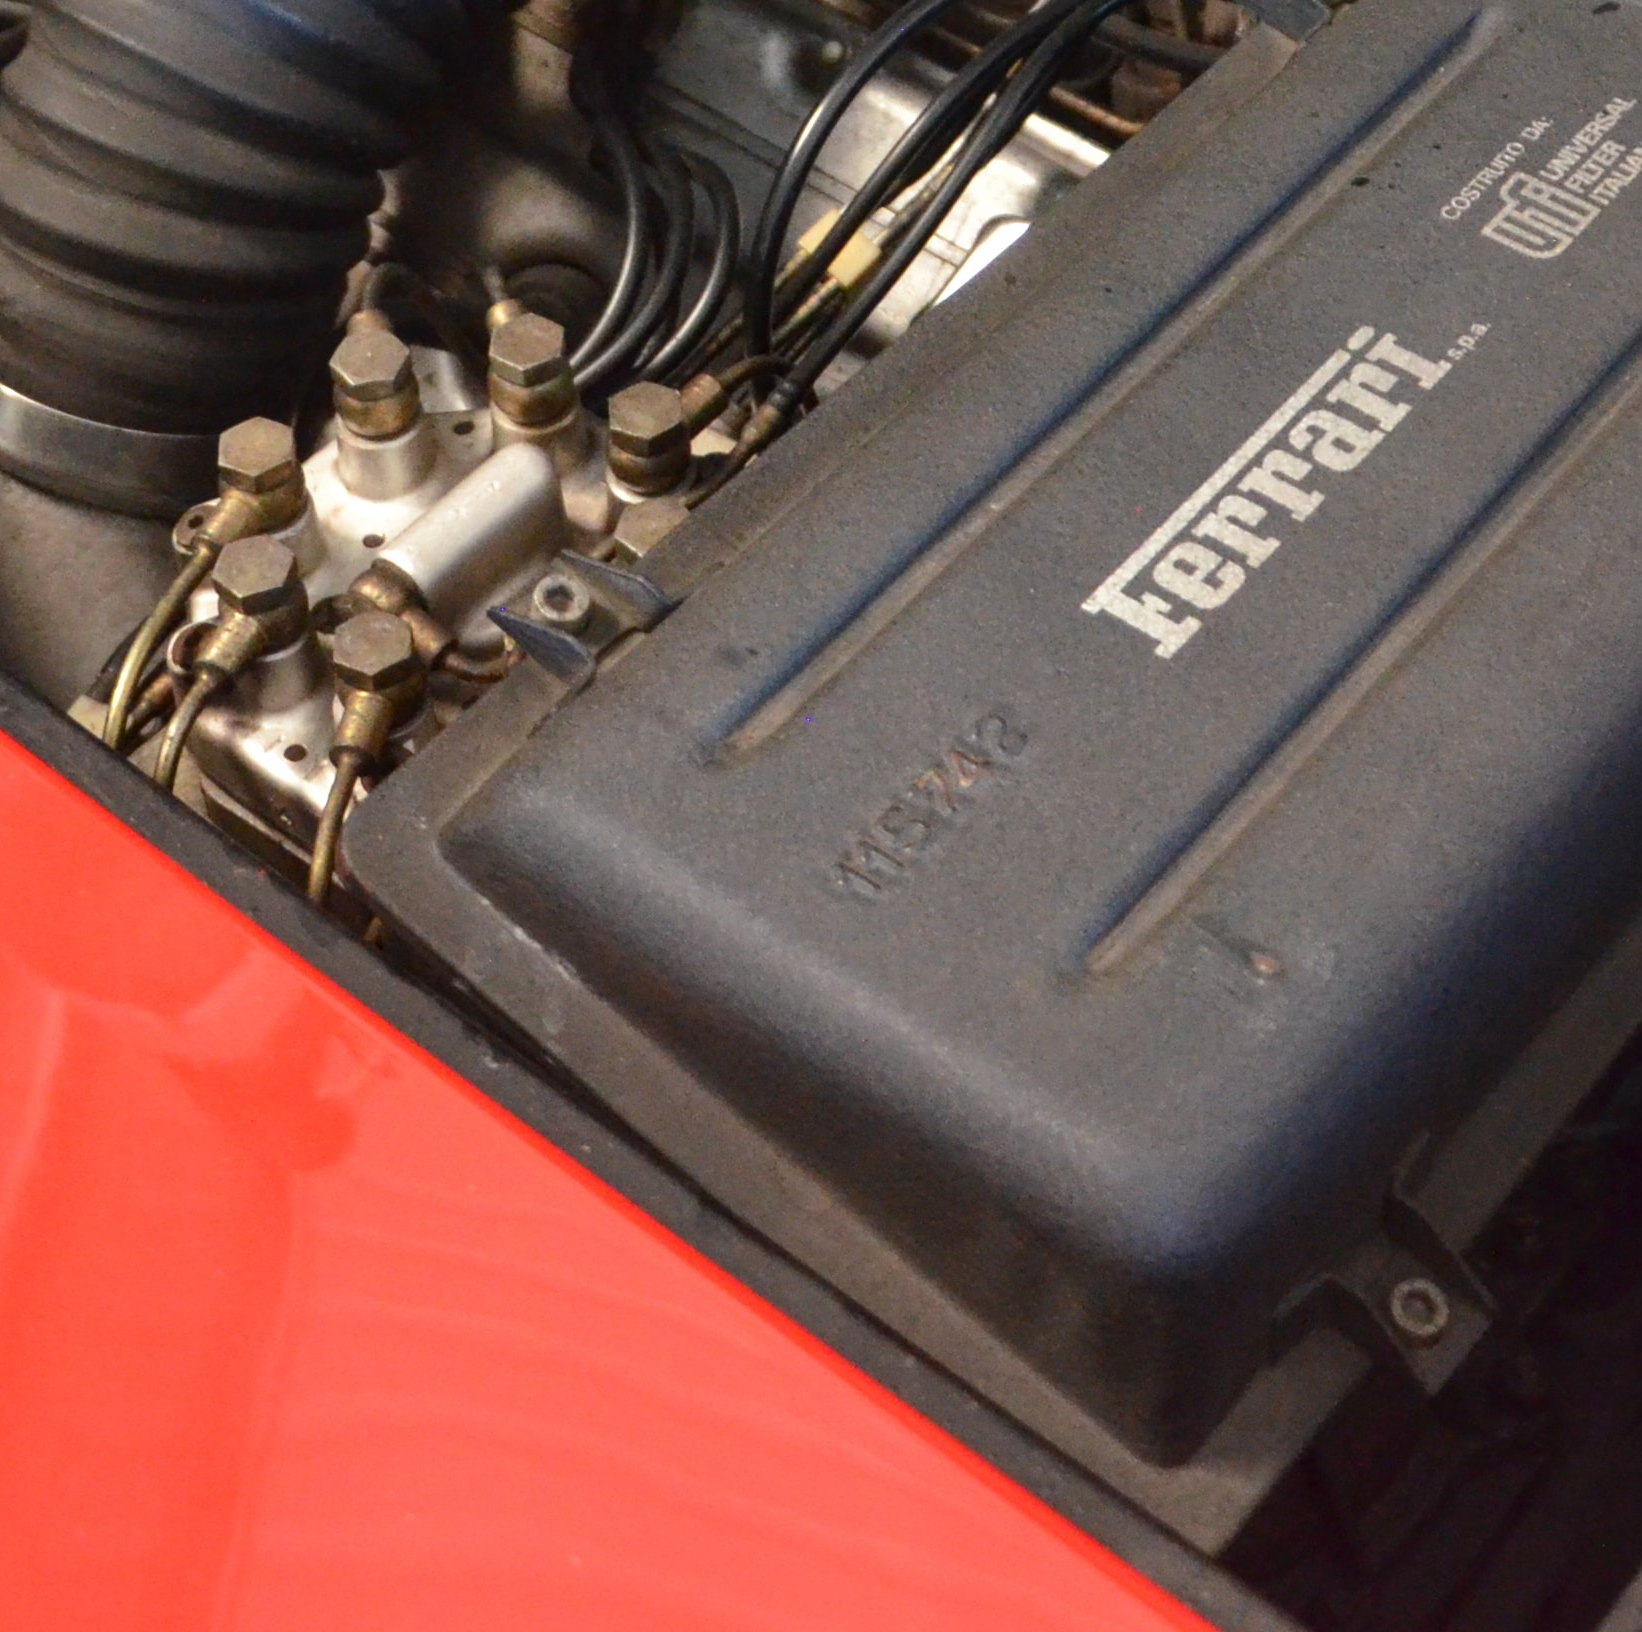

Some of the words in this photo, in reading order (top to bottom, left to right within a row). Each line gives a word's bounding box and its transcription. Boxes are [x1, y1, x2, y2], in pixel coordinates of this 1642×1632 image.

[1540, 97, 1638, 181] UNIVERSAL
[1563, 139, 1626, 194] FILTER
[1440, 142, 1525, 220] COSTRUITO
[1080, 325, 1452, 659] Ferrari
